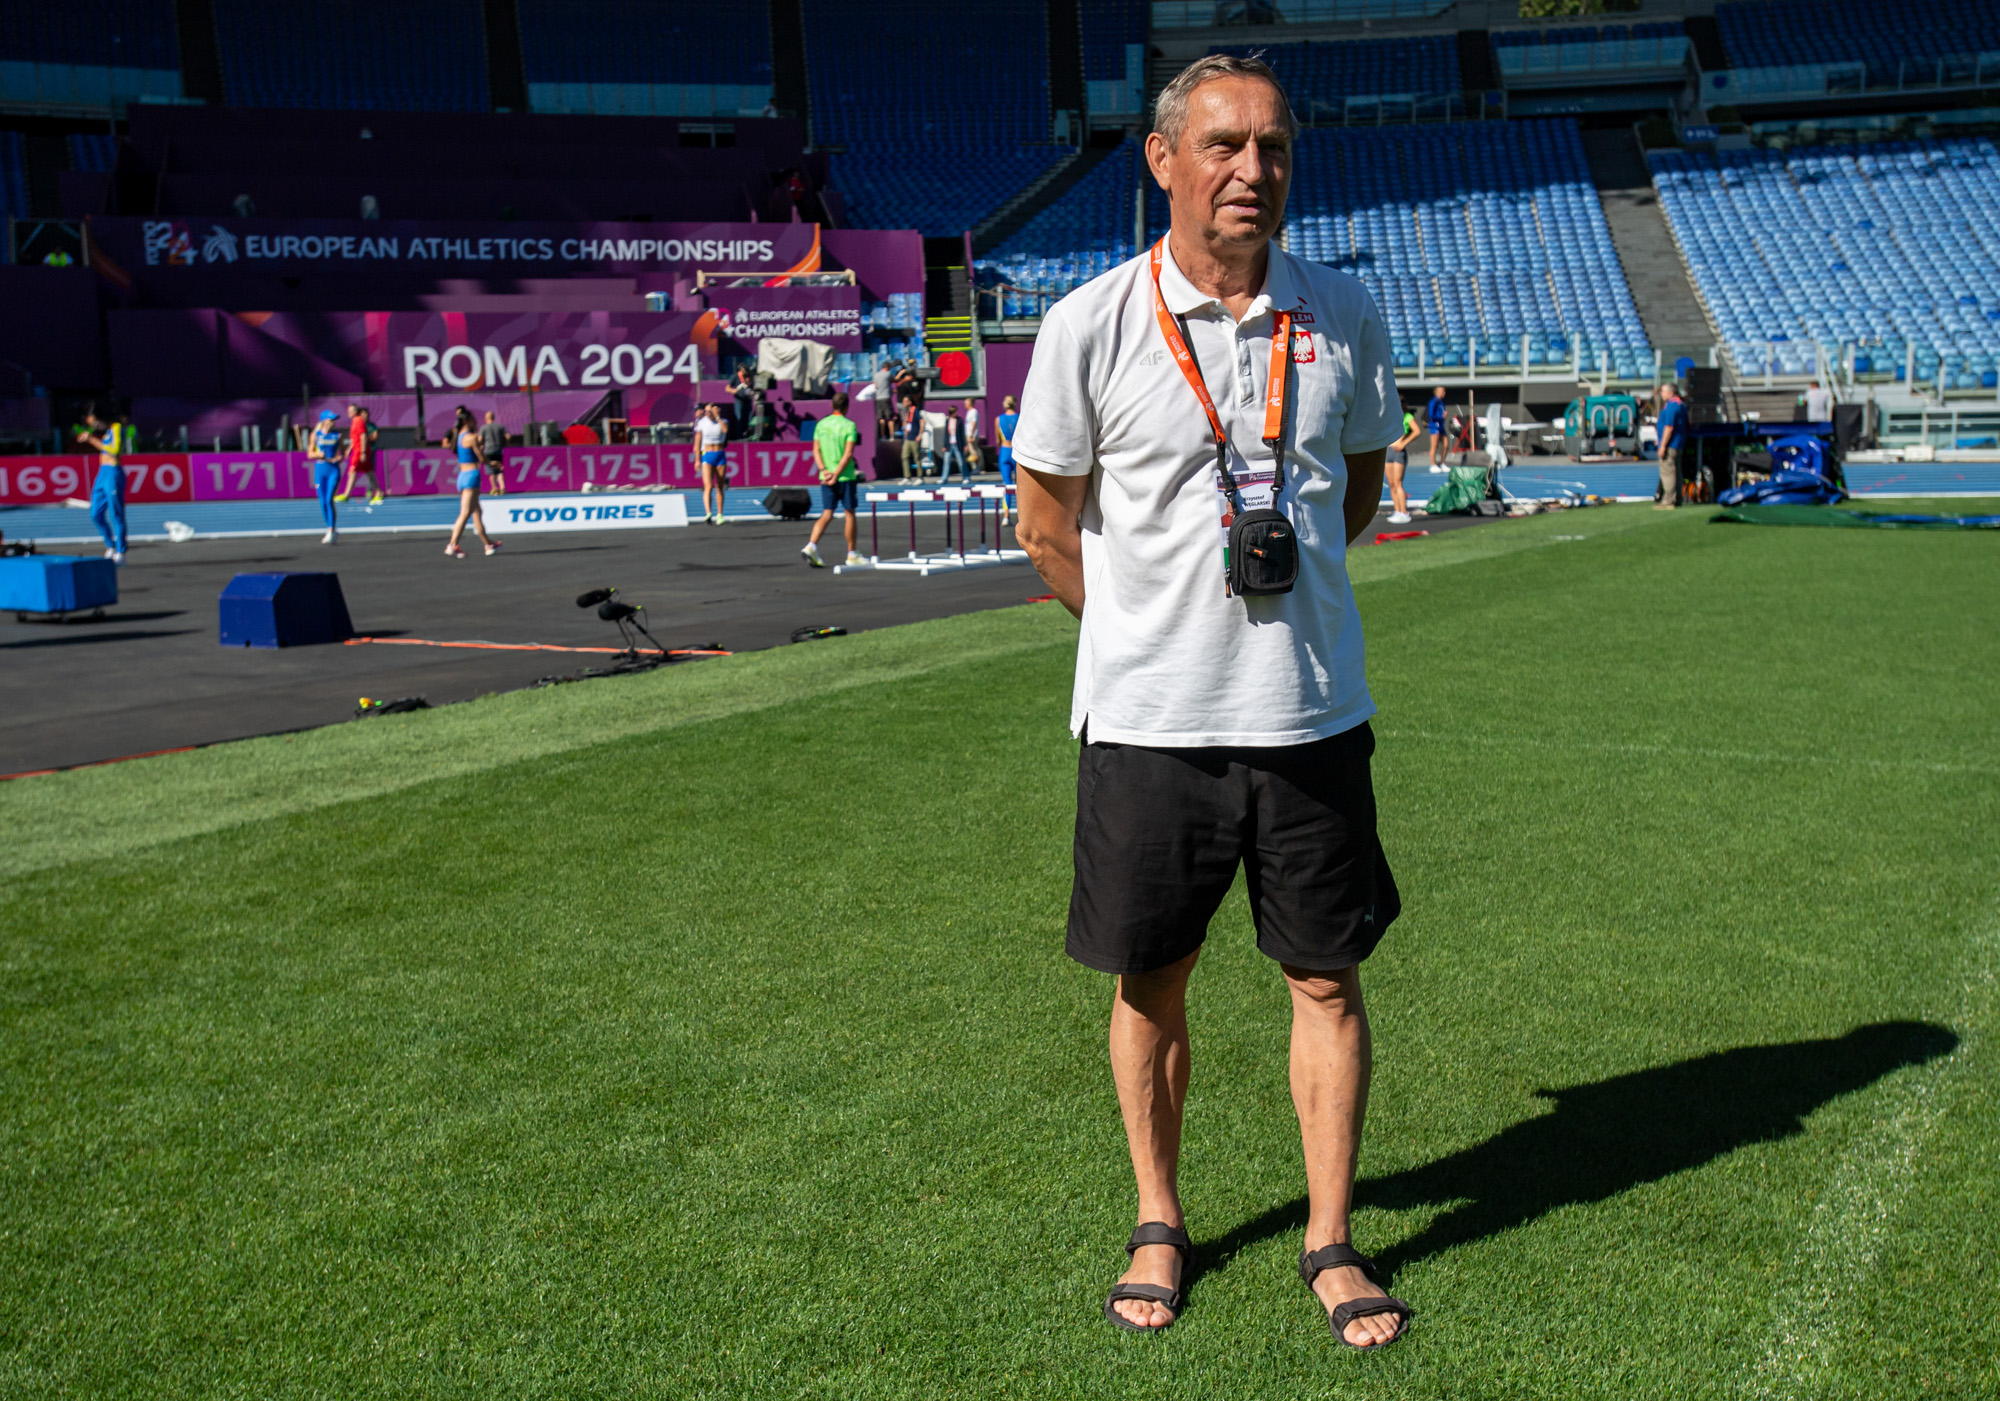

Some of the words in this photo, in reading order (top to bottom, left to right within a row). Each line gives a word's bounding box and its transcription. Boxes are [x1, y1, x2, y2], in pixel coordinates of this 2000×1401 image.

[245, 235, 398, 259] EUROPEAN
[407, 237, 554, 260] ATHLETICS
[560, 239, 774, 262] CHAMPIONSHIPS
[750, 311, 803, 322] EUROPEAN
[805, 309, 859, 320] ATHLETICS
[1291, 313, 1312, 322] LEN
[735, 322, 860, 338] CHAMPIONSHIPS
[403, 345, 570, 388] ROMA
[580, 344, 699, 385] 2024
[123, 463, 183, 494] 70
[206, 461, 276, 492] 171
[509, 455, 563, 483] 74
[581, 453, 650, 481] 175
[509, 507, 577, 523] TOYO
[583, 504, 654, 521] TIRES
